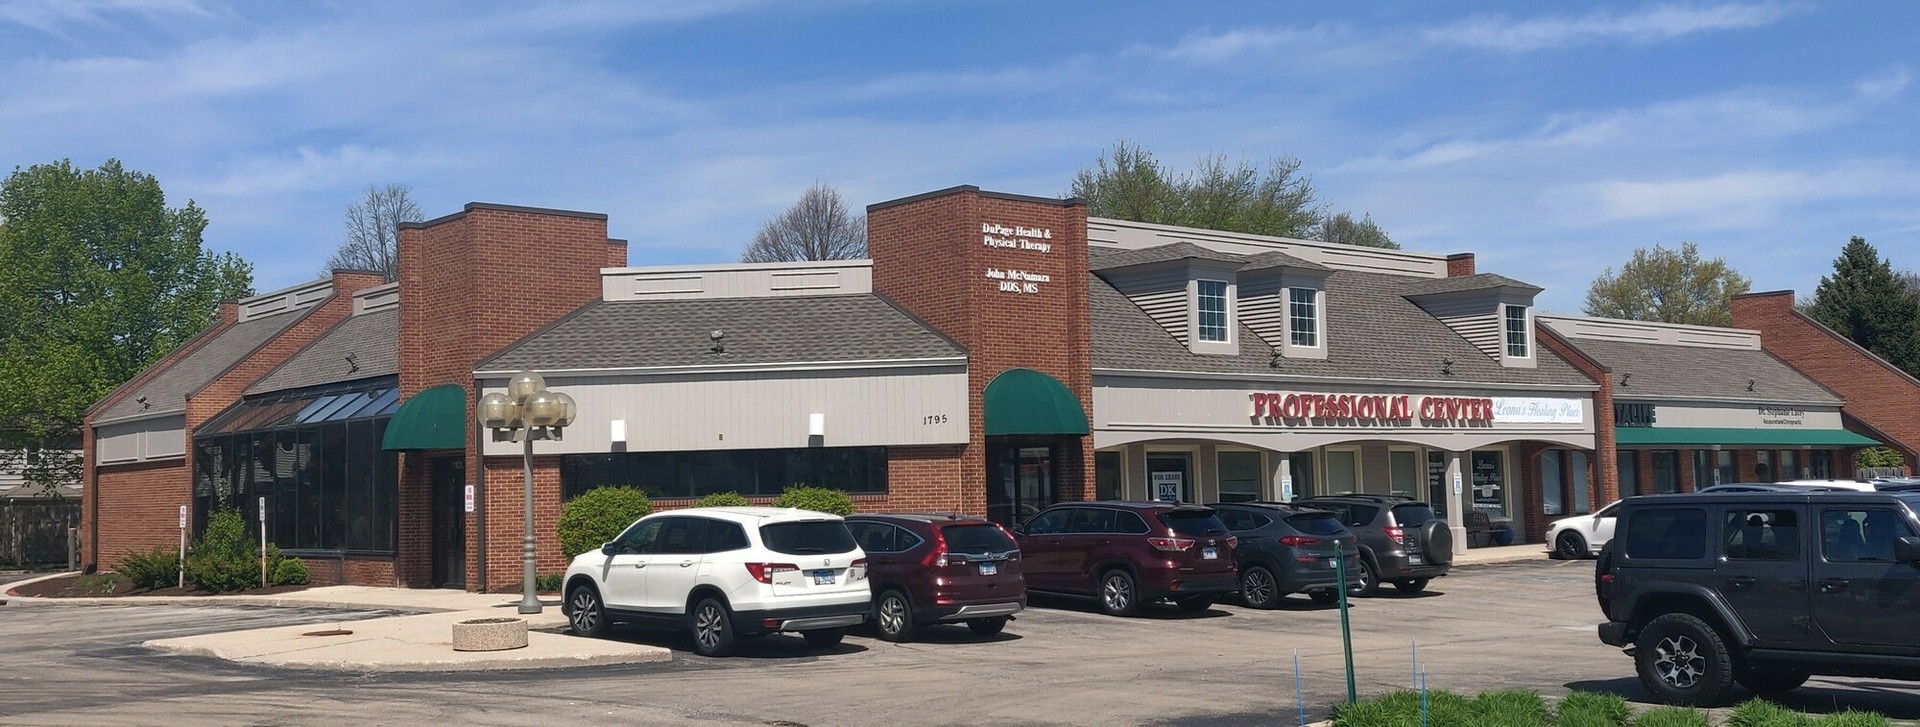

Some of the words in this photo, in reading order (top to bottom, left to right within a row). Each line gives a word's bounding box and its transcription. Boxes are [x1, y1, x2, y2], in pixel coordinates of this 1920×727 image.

[982, 223, 1013, 237] DuPage
[1015, 226, 1043, 239] Health
[1044, 229, 1052, 239] &
[984, 236, 1016, 248] Physical
[1019, 239, 1051, 252] Therapy
[985, 268, 1005, 279] John
[1007, 269, 1050, 282] McNamara
[1000, 281, 1021, 294] DDS,
[1023, 283, 1038, 294] MS
[1252, 392, 1414, 420] PROFESSIONAL
[1420, 396, 1495, 422] CENTER
[1494, 399, 1526, 416] Leona's
[1528, 402, 1557, 419] Healing
[1558, 401, 1581, 418] Place
[923, 414, 948, 425] 1795
[1160, 484, 1176, 496] DK
